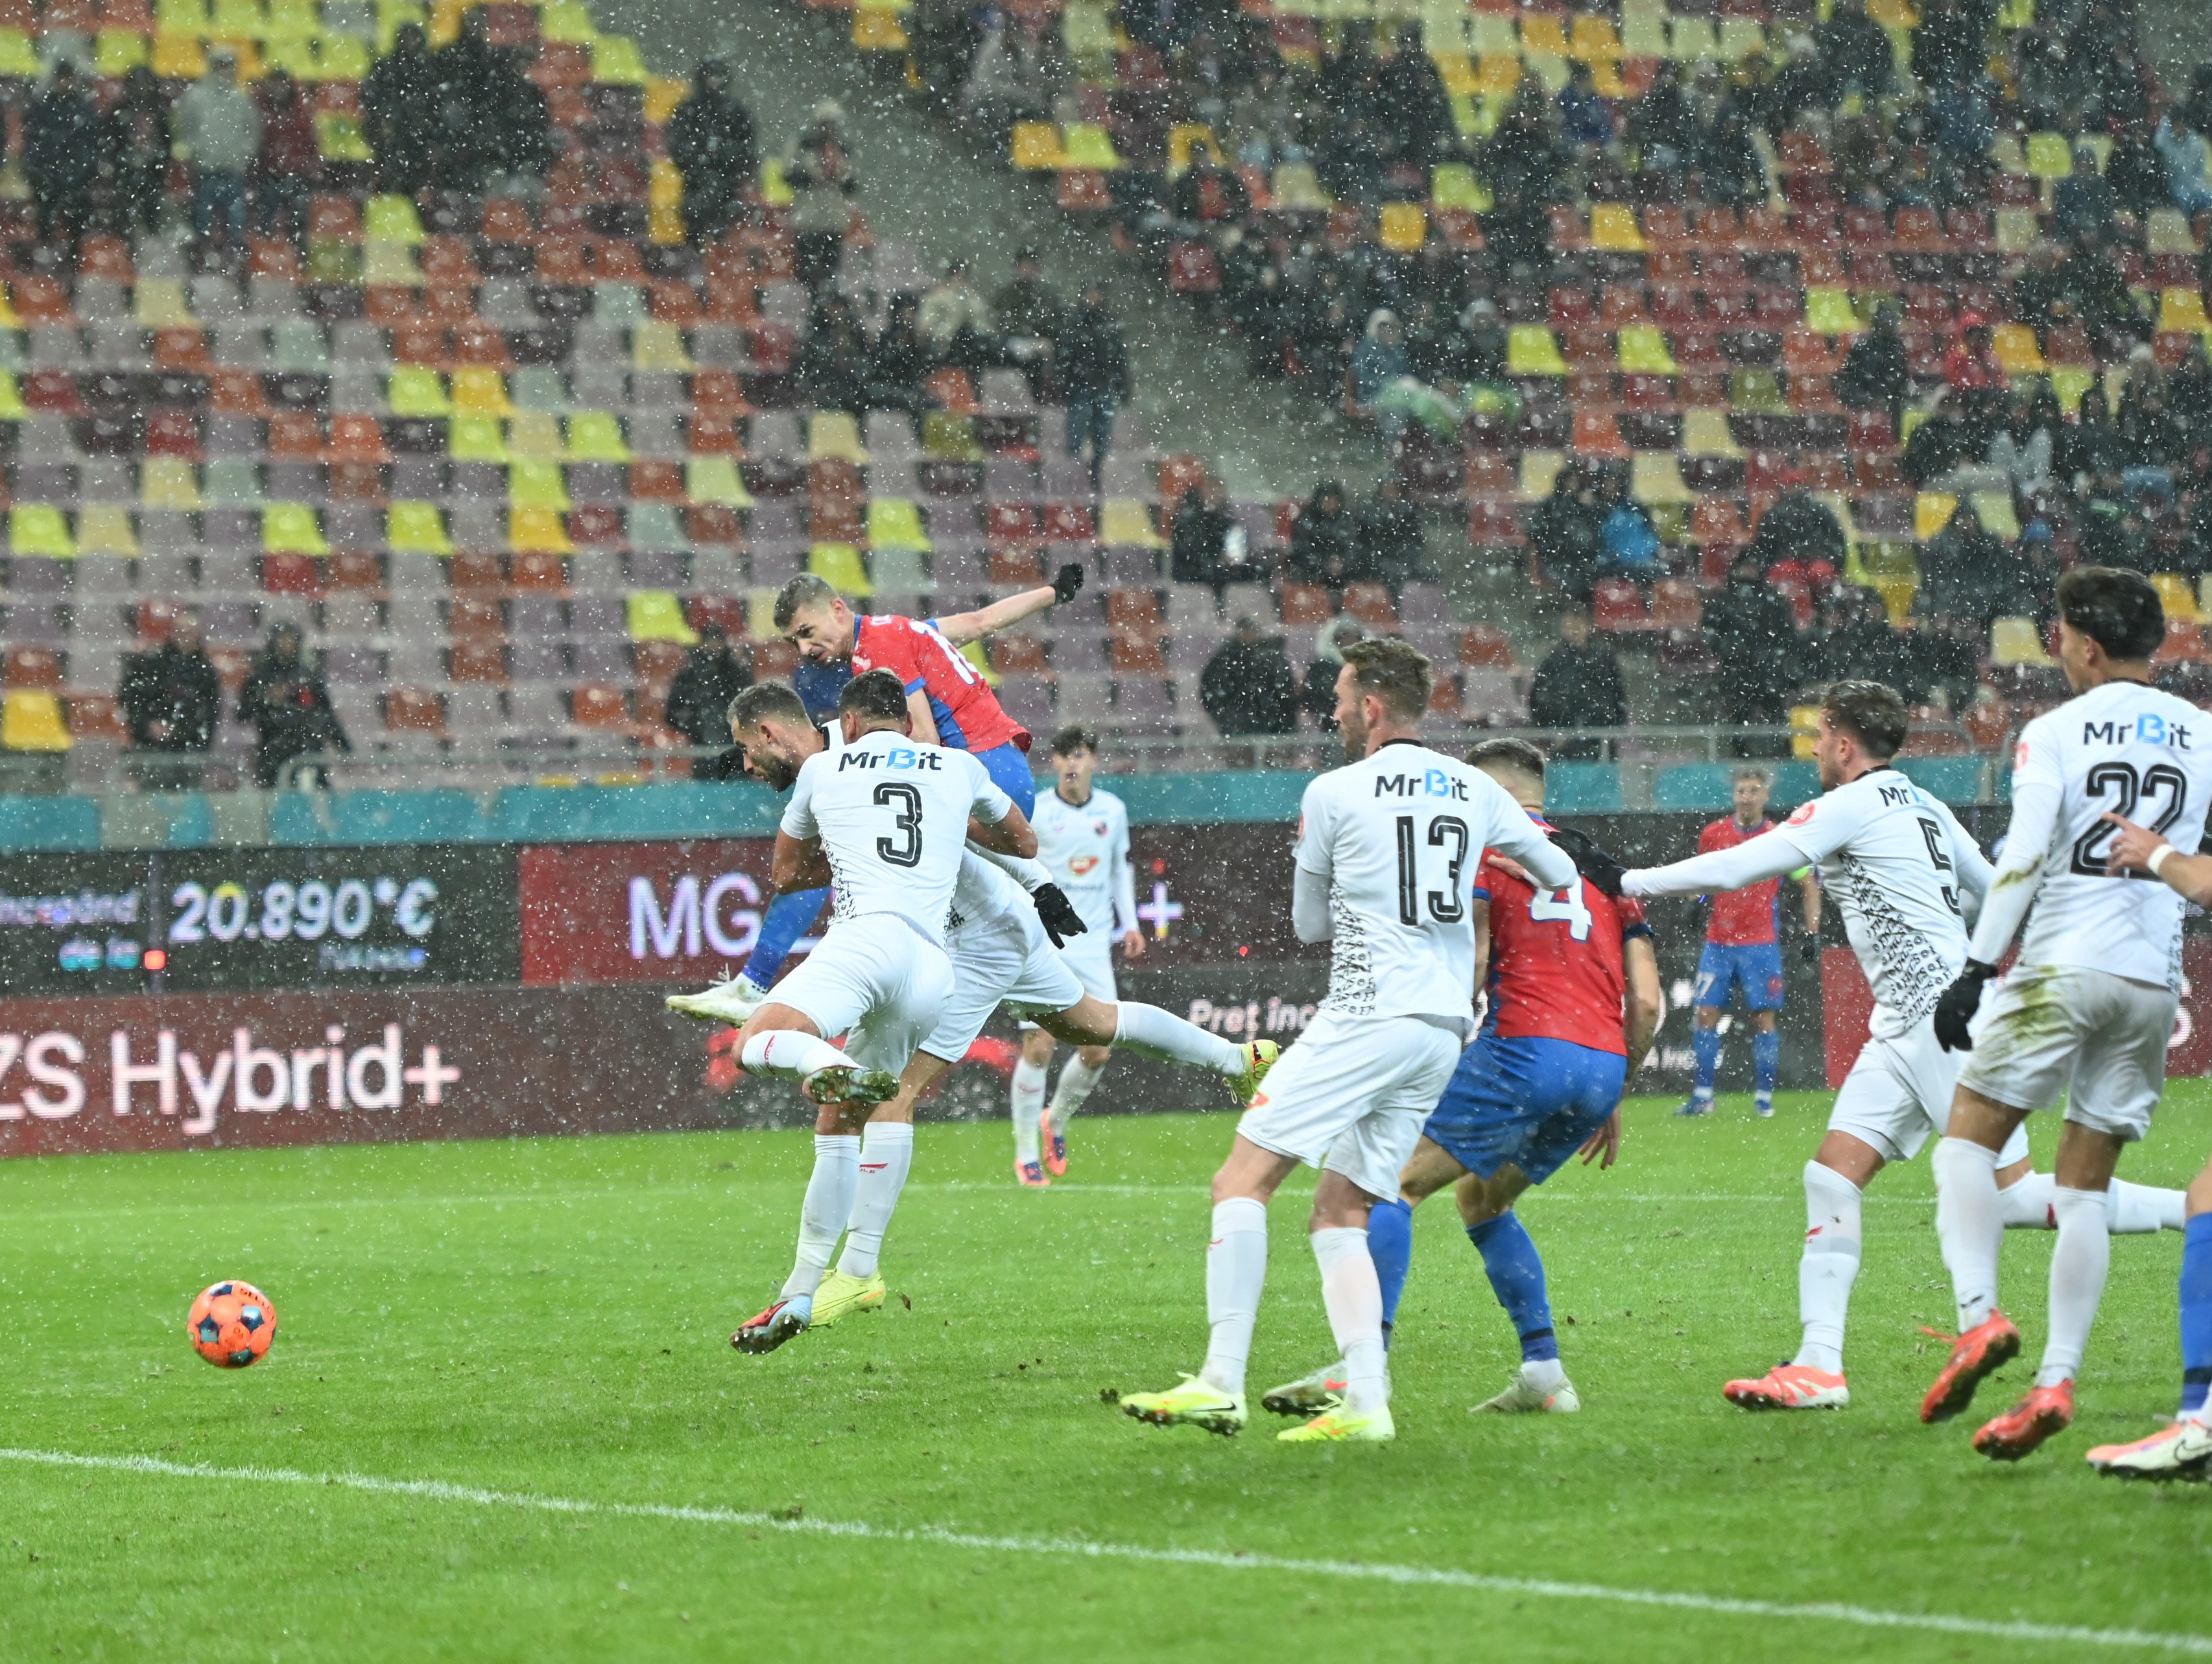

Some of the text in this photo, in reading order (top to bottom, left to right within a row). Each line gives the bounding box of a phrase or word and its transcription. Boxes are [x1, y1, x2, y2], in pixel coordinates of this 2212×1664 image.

[839, 748, 942, 773] MrBit
[2084, 713, 2191, 750] MrBit
[874, 782, 923, 868] 3
[1375, 768, 1469, 802] MrBit
[2071, 761, 2187, 881] 22
[1396, 815, 1469, 925] 13
[1530, 877, 1593, 942] 4
[1917, 817, 1961, 916] 5
[630, 872, 763, 959] MG
[111, 1023, 461, 1135] Hybrid+
